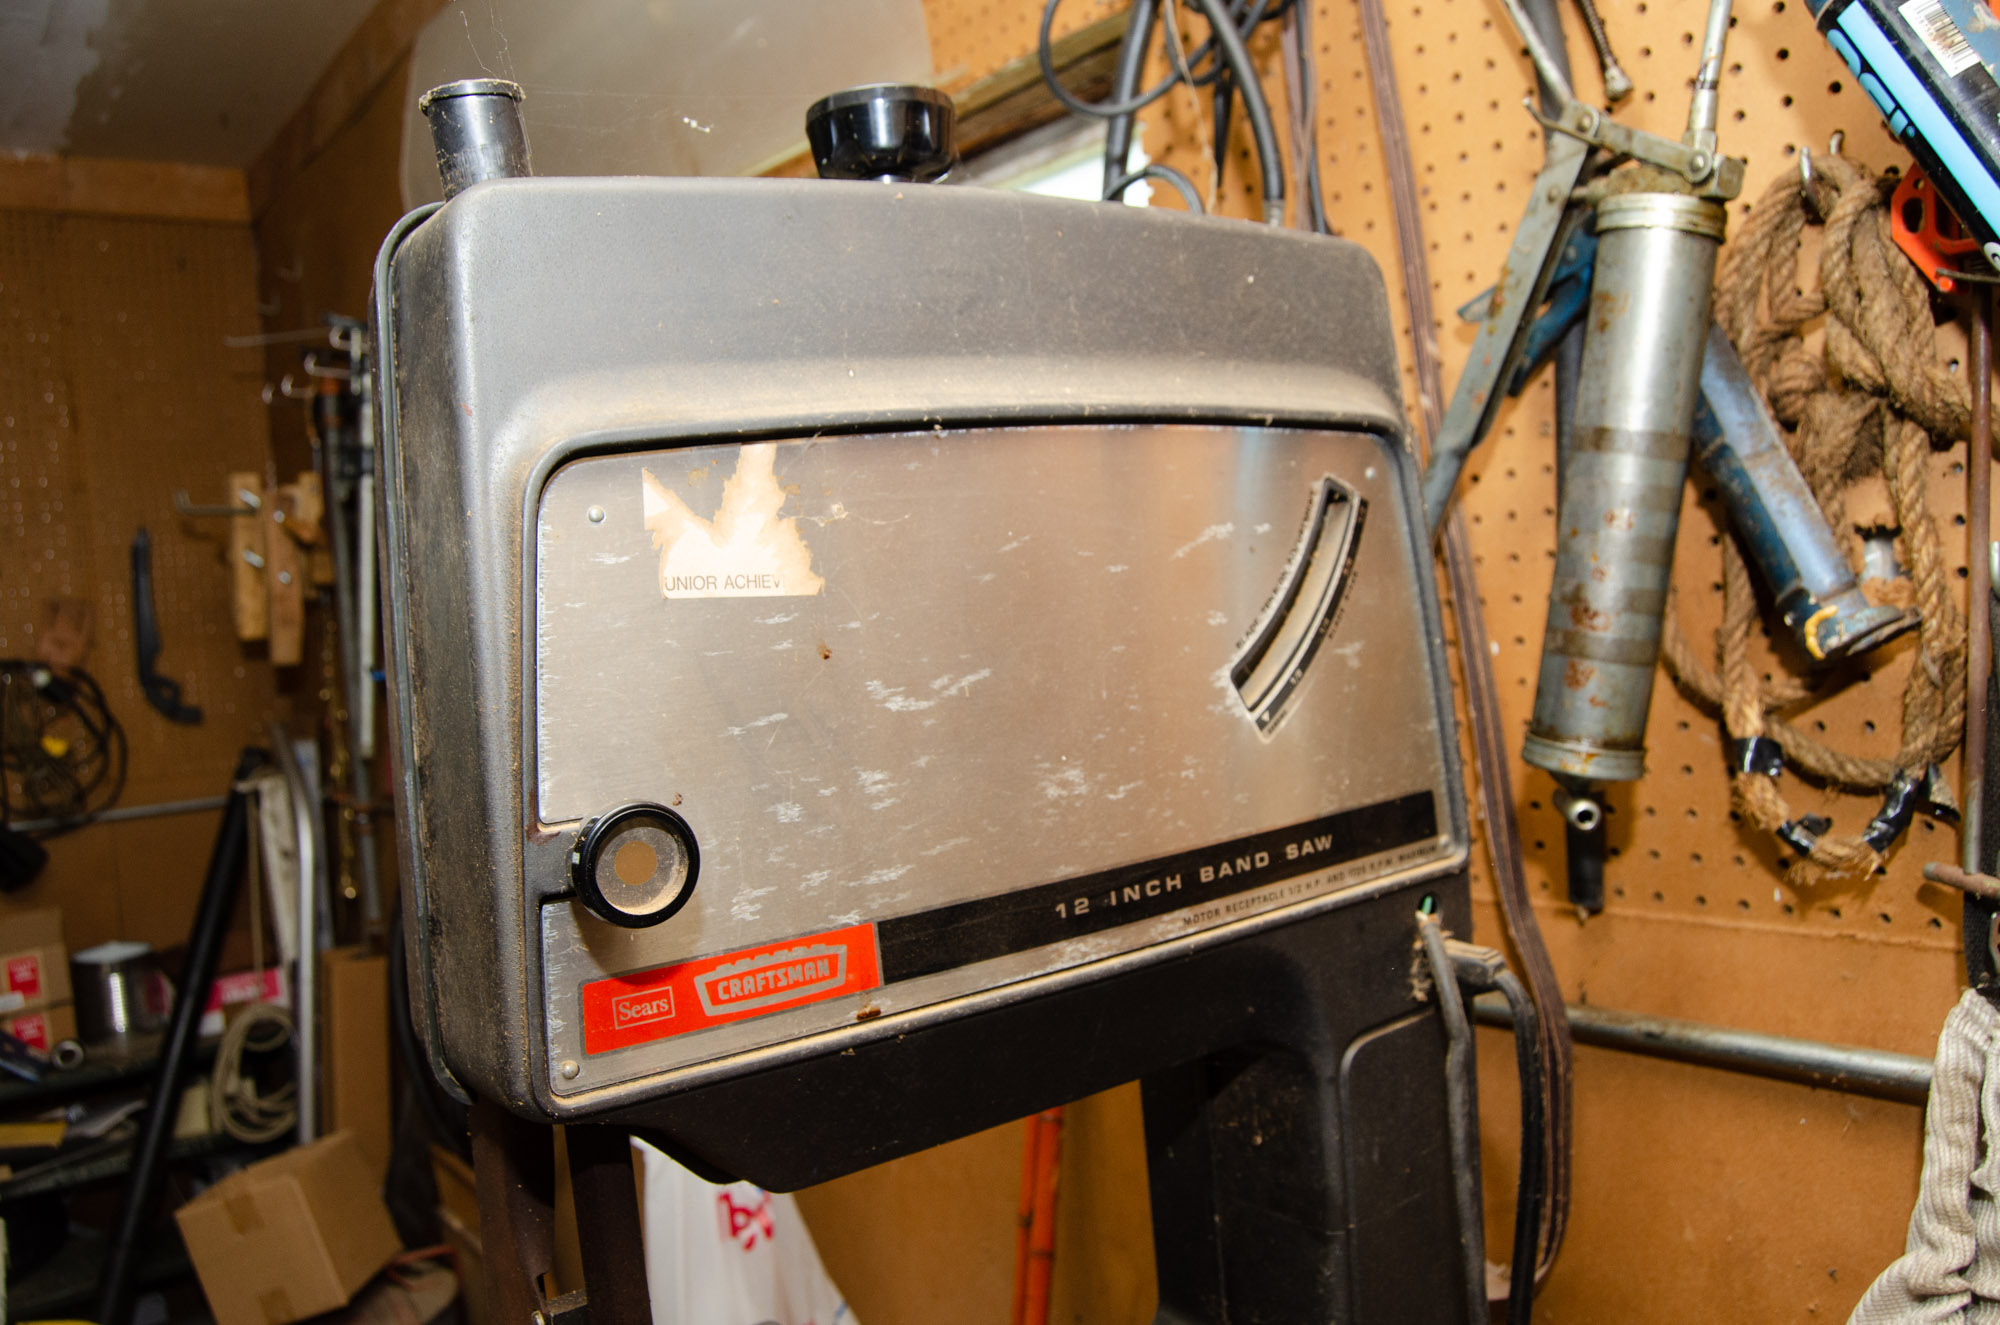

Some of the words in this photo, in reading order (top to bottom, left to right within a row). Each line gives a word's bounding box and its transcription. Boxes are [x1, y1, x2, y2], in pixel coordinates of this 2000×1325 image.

[1055, 897, 1091, 919] 12
[1109, 873, 1183, 907] INCH
[1199, 851, 1270, 884] BAND
[1284, 833, 1333, 860] SAW
[1183, 907, 1220, 927] MOTOR
[1225, 888, 1285, 913] RECEPTACLE
[717, 958, 831, 1001] CRAFTSMAN
[618, 998, 669, 1022] Sears
